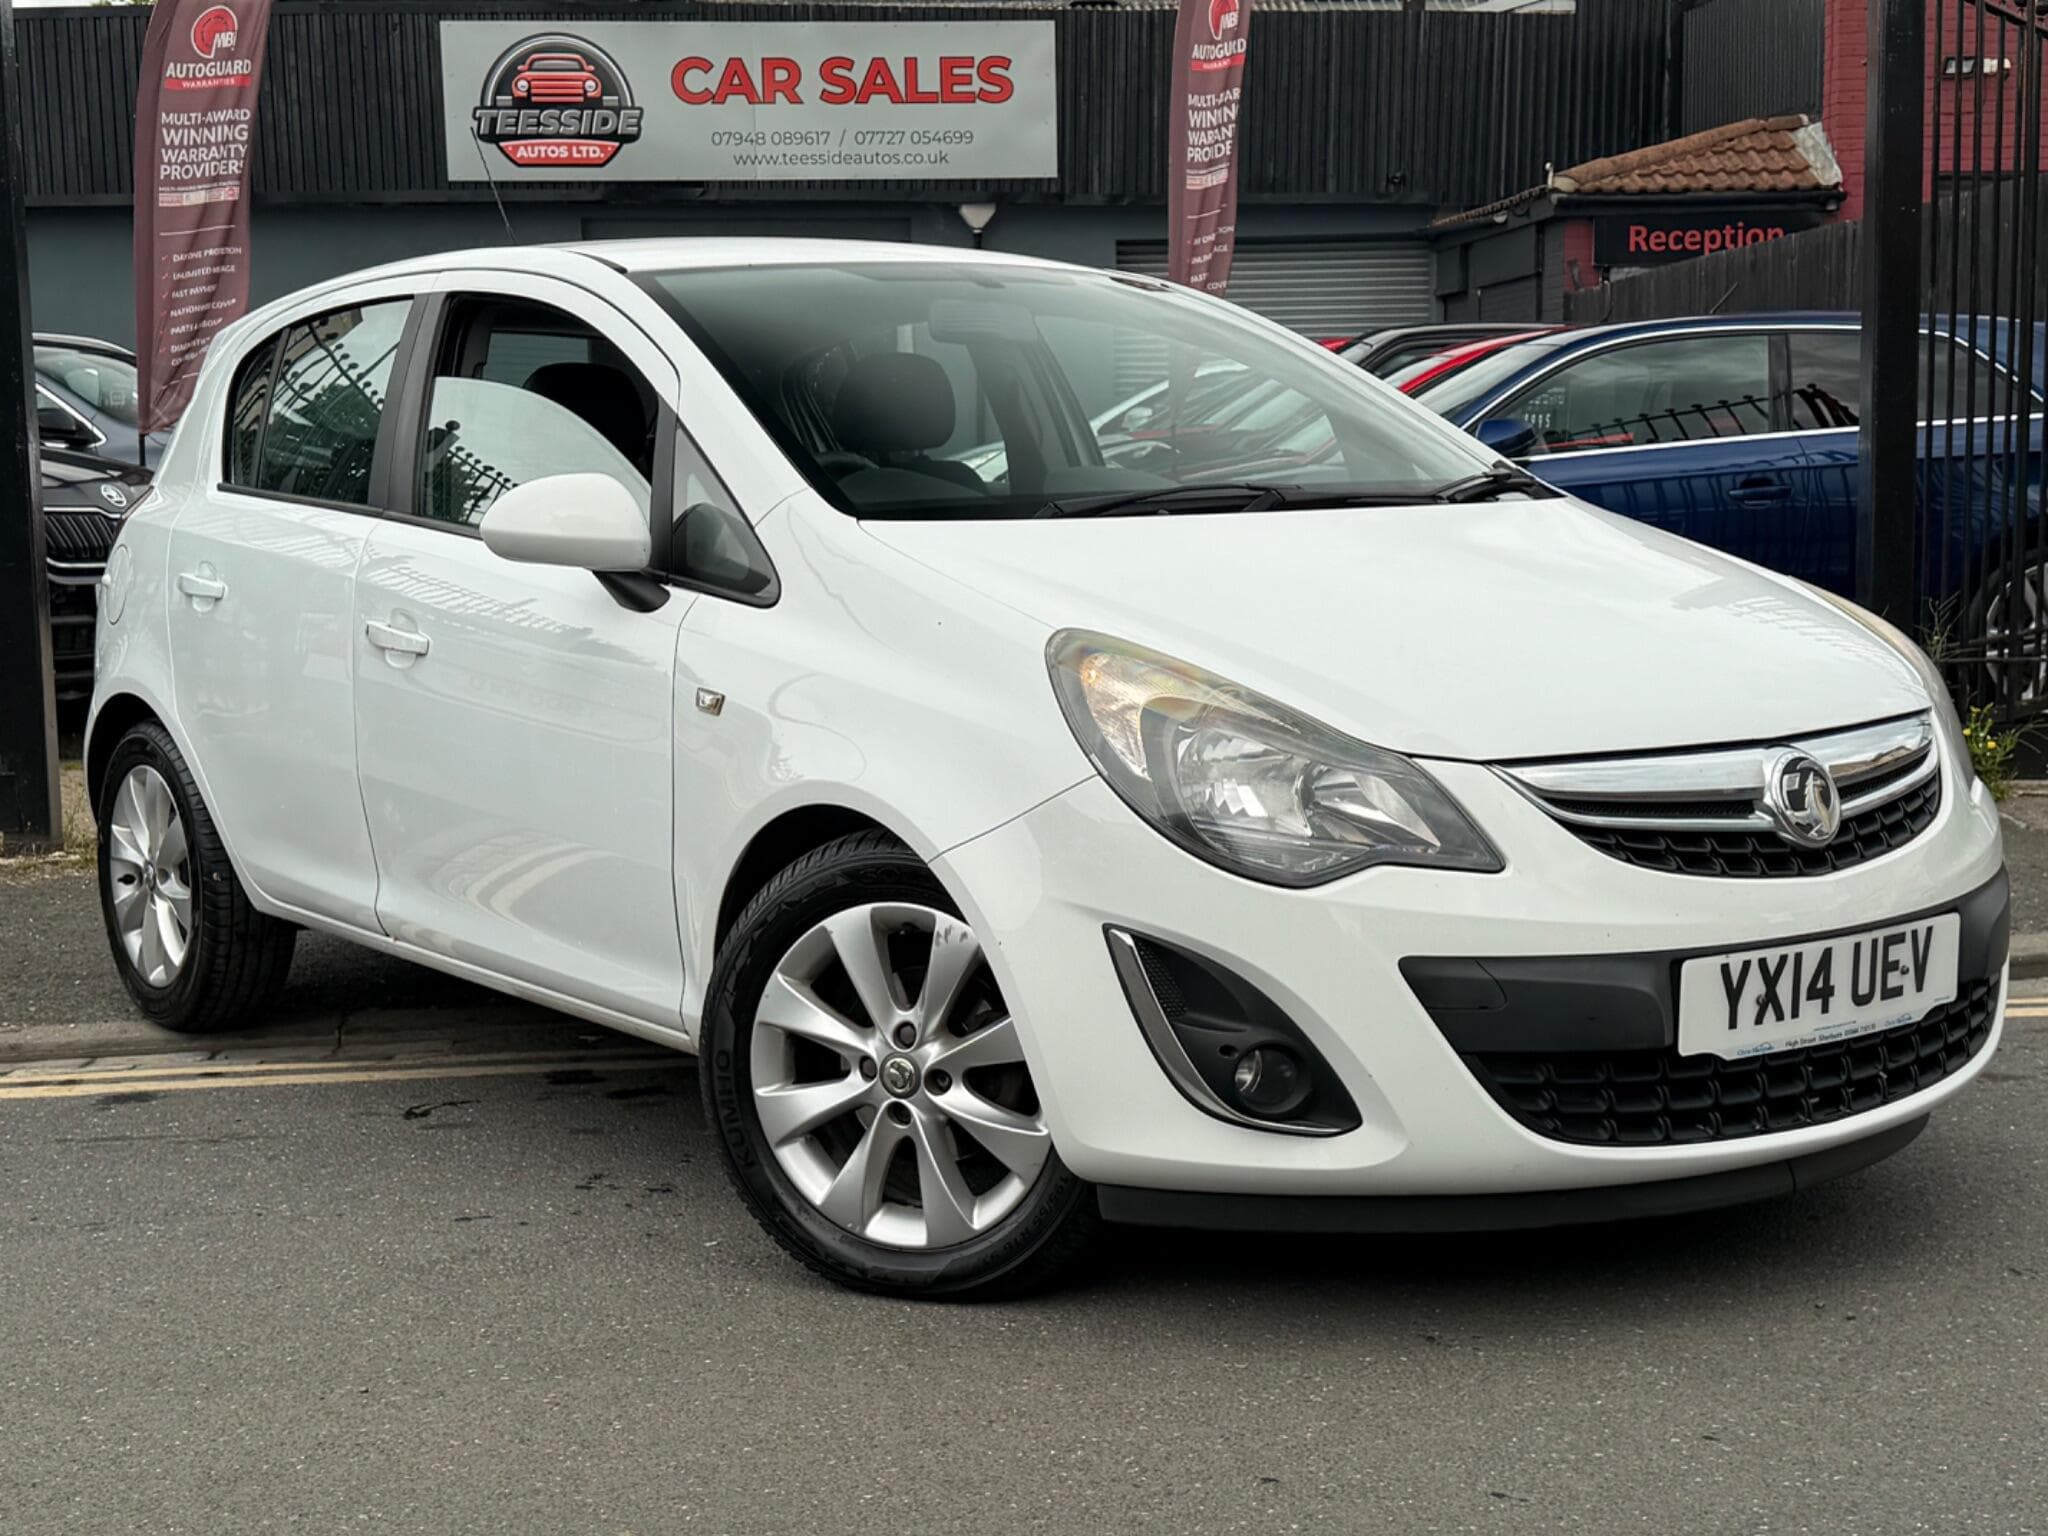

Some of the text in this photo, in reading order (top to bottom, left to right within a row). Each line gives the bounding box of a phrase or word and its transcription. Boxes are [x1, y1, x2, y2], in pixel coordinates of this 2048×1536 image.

[1191, 38, 1247, 60] AUTOGUD
[166, 59, 252, 78] AUTOGUARD
[670, 55, 1015, 105] CAR SALES
[161, 108, 251, 126] MULTI-AWARD
[474, 107, 644, 136] TEESSIDE
[162, 124, 249, 146] WINNING
[711, 130, 766, 147] 07948
[770, 130, 831, 147] 089617
[853, 129, 907, 146] 07727
[910, 129, 974, 146] 054699
[161, 144, 248, 163] WARRANTY
[516, 145, 606, 159] AUTOS LTD.
[733, 149, 950, 168] www.teessideautos.co.uk
[1207, 280, 1227, 290] COVE
[1719, 925, 1935, 1031] YX14 UEV
[714, 1048, 755, 1168] KUMHO
